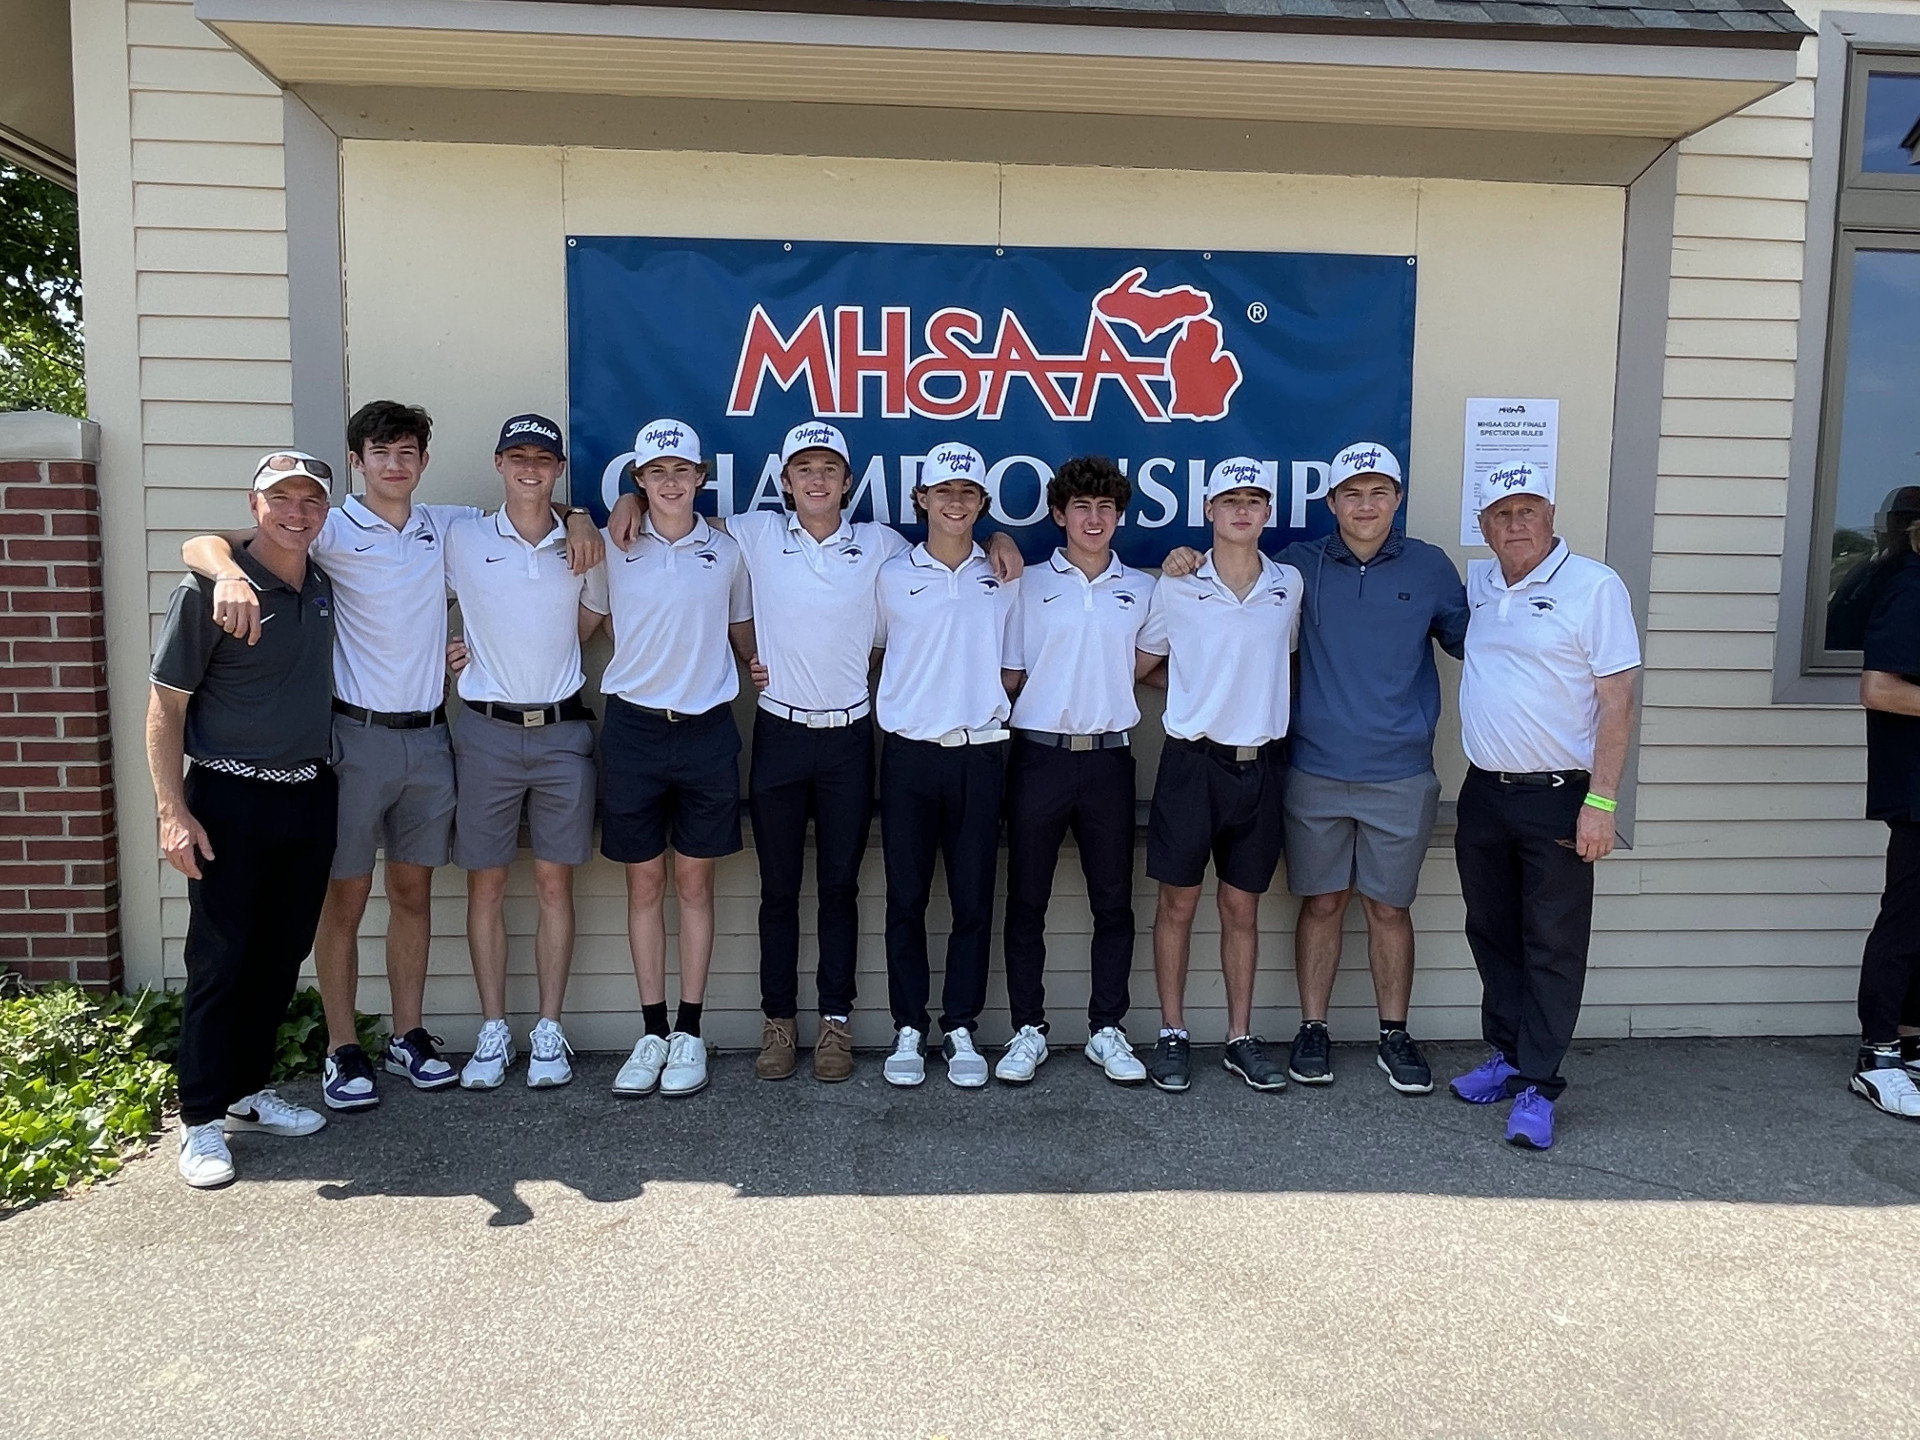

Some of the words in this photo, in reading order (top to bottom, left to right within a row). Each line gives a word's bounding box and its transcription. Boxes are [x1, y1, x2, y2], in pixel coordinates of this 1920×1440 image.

[726, 300, 1172, 423] MHSAA
[505, 420, 559, 441] Titleist
[645, 426, 684, 444] Hawks
[1480, 429, 1520, 437] SPECTATOR
[657, 437, 679, 450] Golf
[937, 450, 977, 465] Hawks
[1341, 447, 1382, 466] Hawks
[1354, 456, 1377, 471] Golf
[950, 460, 972, 473] Golf
[1234, 472, 1256, 484] Golf
[1489, 464, 1533, 486] Hawks
[1503, 475, 1527, 490] Golf
